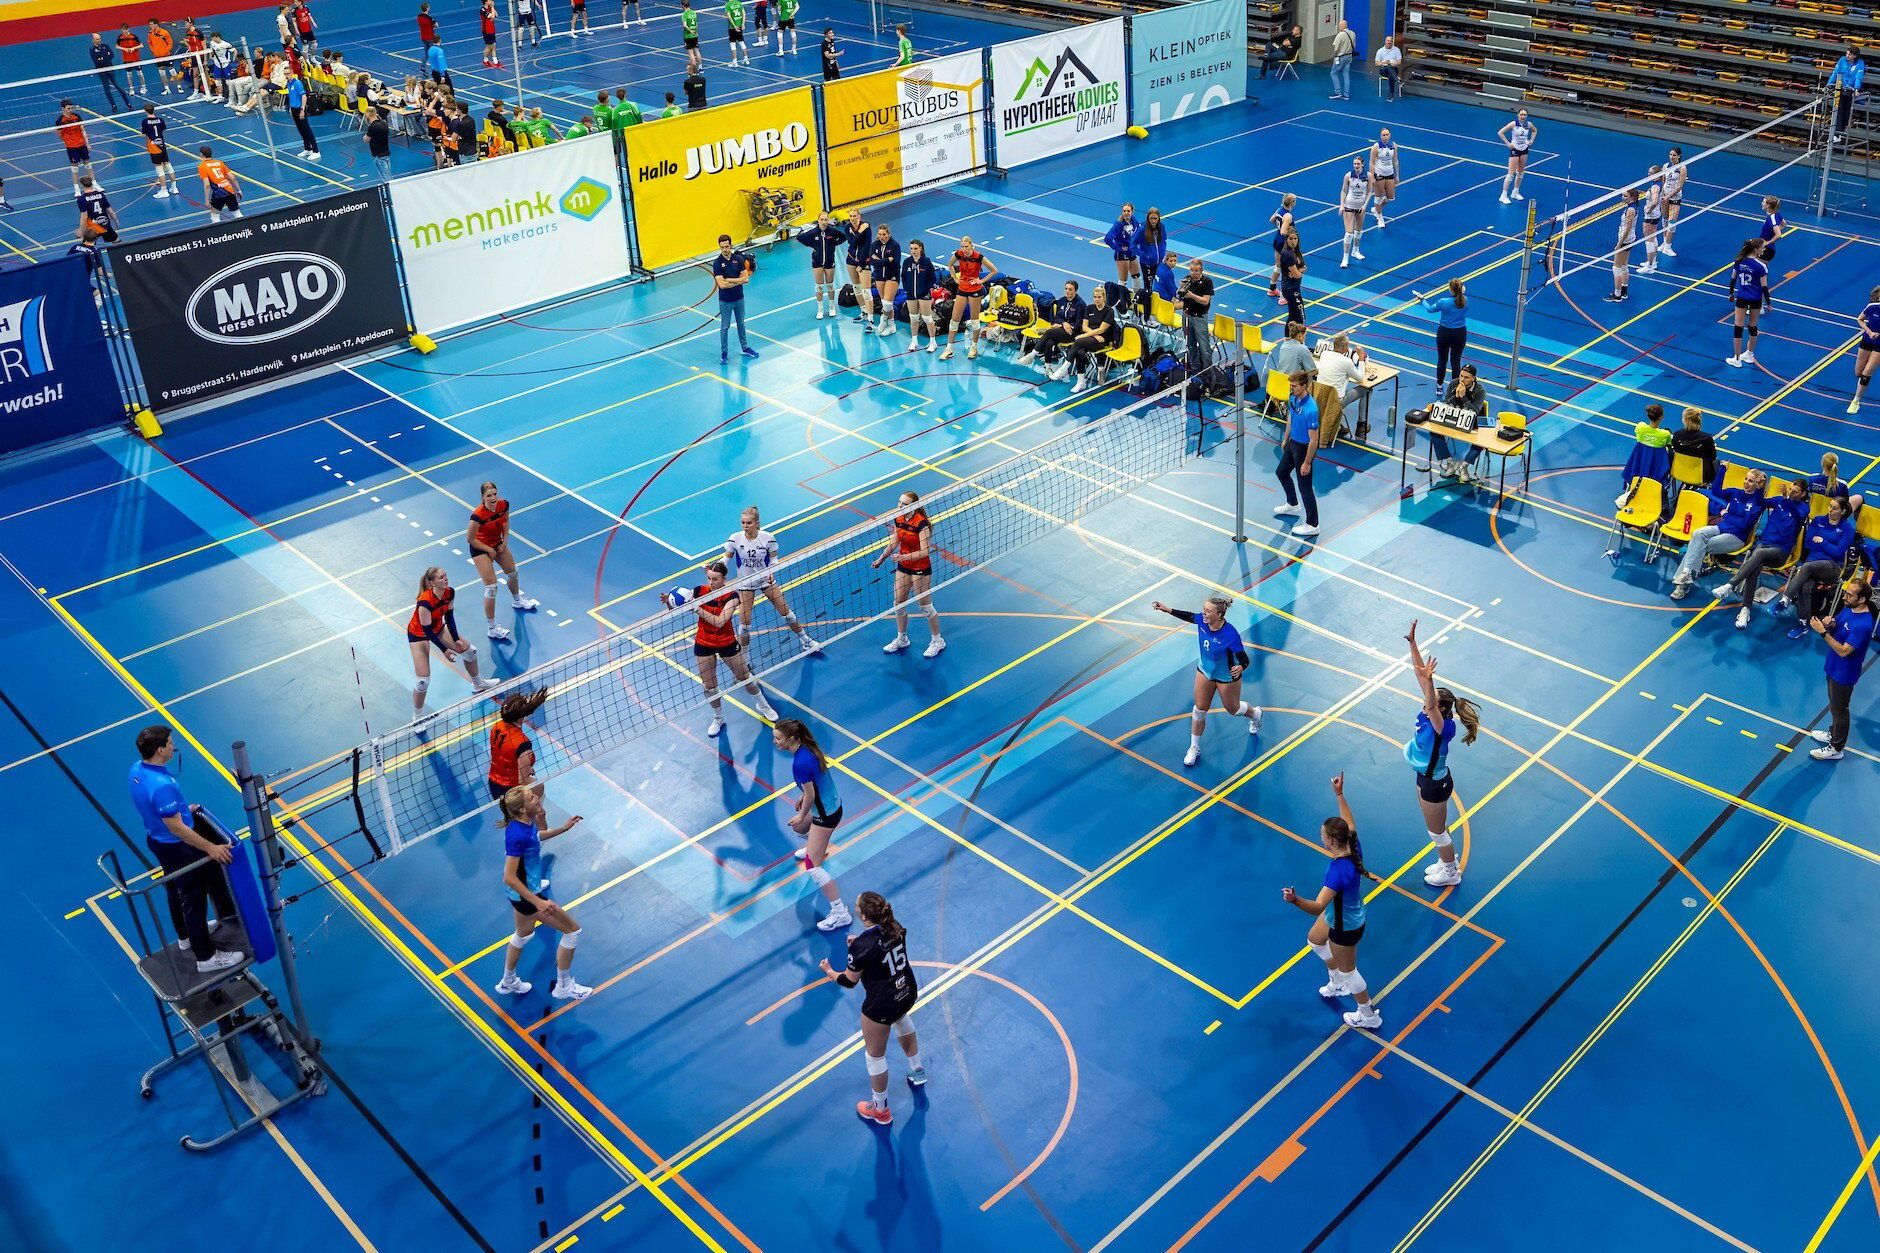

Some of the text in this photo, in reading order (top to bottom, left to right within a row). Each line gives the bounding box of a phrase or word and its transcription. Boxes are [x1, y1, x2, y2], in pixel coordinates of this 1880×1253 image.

[1149, 30, 1231, 63] KLEIN OPTIEK
[1150, 61, 1232, 89] ZIEN IS BELEVEN
[853, 90, 959, 131] HOUTKUBUS
[1076, 103, 1118, 132] OP MAAT
[153, 125, 158, 137] 1
[683, 121, 809, 181] JUMBO
[639, 160, 678, 182] Hallo
[757, 157, 812, 179] Wiegmans
[93, 201, 103, 214] 4
[569, 190, 591, 210] m
[269, 201, 369, 231] Marktplein 17, Apeldoorn
[408, 191, 555, 248] mennink
[134, 228, 254, 262] Bruggestraat 51, Harderwijk
[482, 221, 558, 250] Makelaars
[1739, 272, 1752, 286] 12
[213, 265, 328, 325] MAJO
[219, 307, 289, 334] verse friet
[299, 326, 394, 361] Marktplein 17, Apeldoorn
[0, 347, 30, 384] R
[170, 358, 284, 397] Bruggestraat 51, Harderwijk
[1459, 413, 1472, 428] 10
[746, 549, 756, 558] 12
[492, 730, 507, 748] 11
[881, 943, 907, 977] 15
